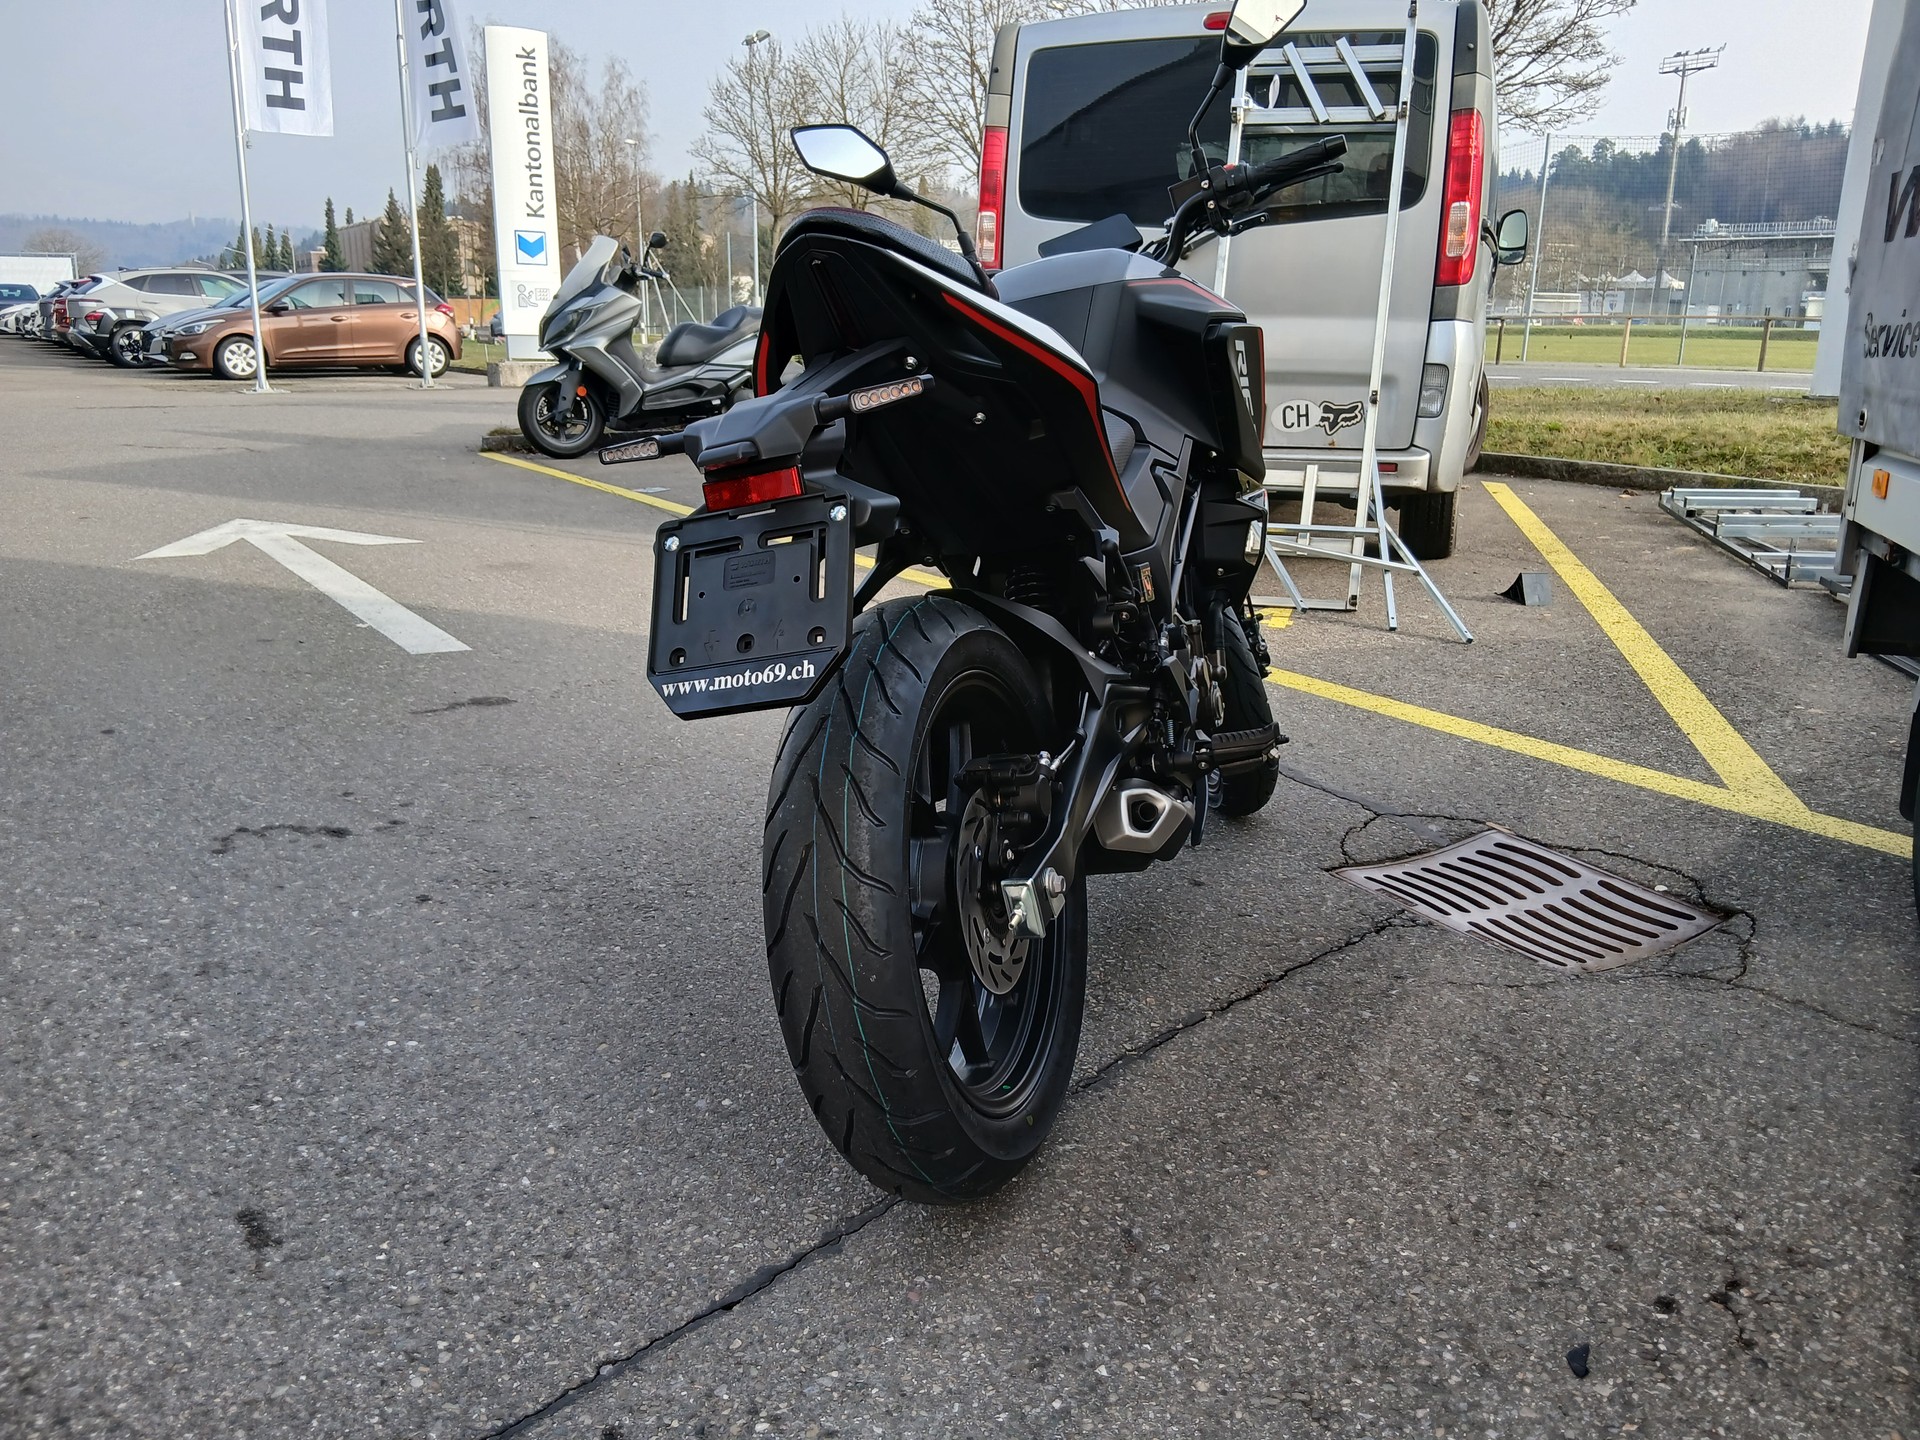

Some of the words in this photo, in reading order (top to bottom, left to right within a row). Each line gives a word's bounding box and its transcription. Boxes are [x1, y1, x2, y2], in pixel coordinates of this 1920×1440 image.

[516, 46, 545, 218] Kantonalbank
[1864, 308, 1920, 358] Service
[1282, 404, 1309, 429] CH
[662, 660, 815, 696] www.moto69.ch
